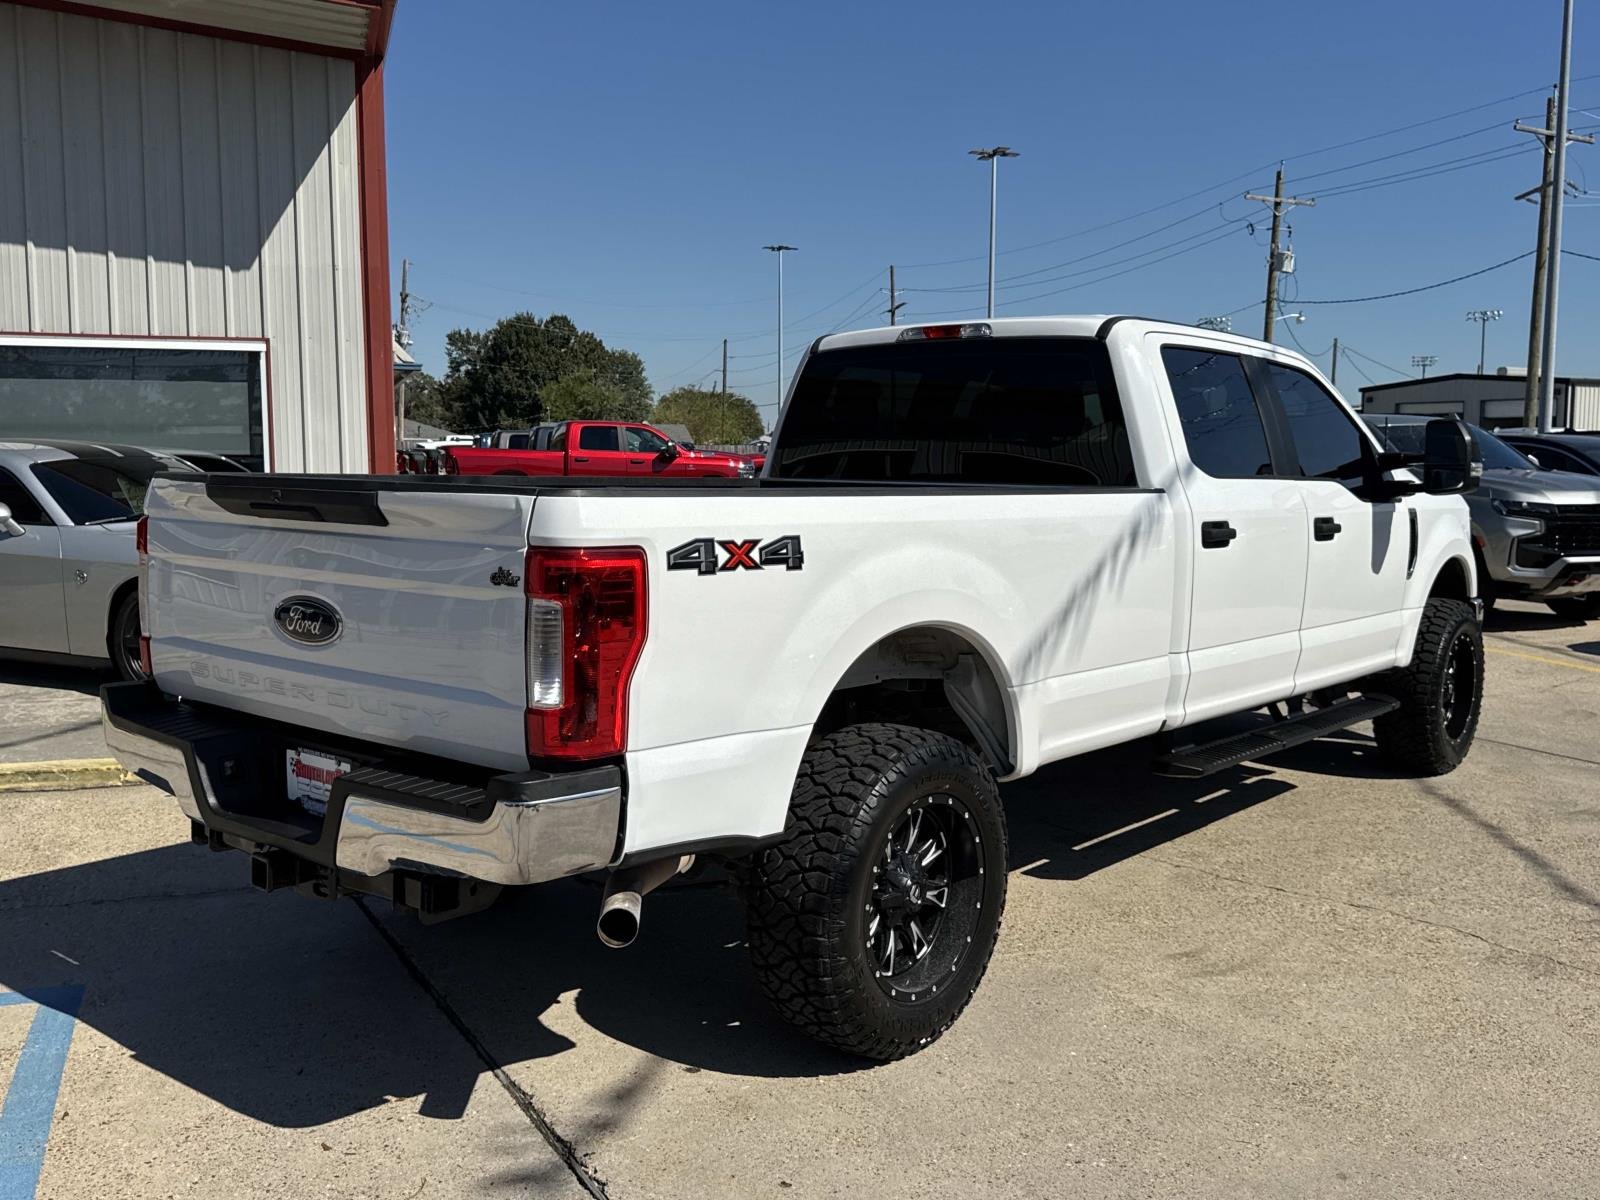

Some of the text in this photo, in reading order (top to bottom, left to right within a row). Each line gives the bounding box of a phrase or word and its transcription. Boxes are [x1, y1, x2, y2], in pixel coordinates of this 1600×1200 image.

[286, 605, 323, 635] Ford
[191, 660, 450, 727] SUPER DUTY
